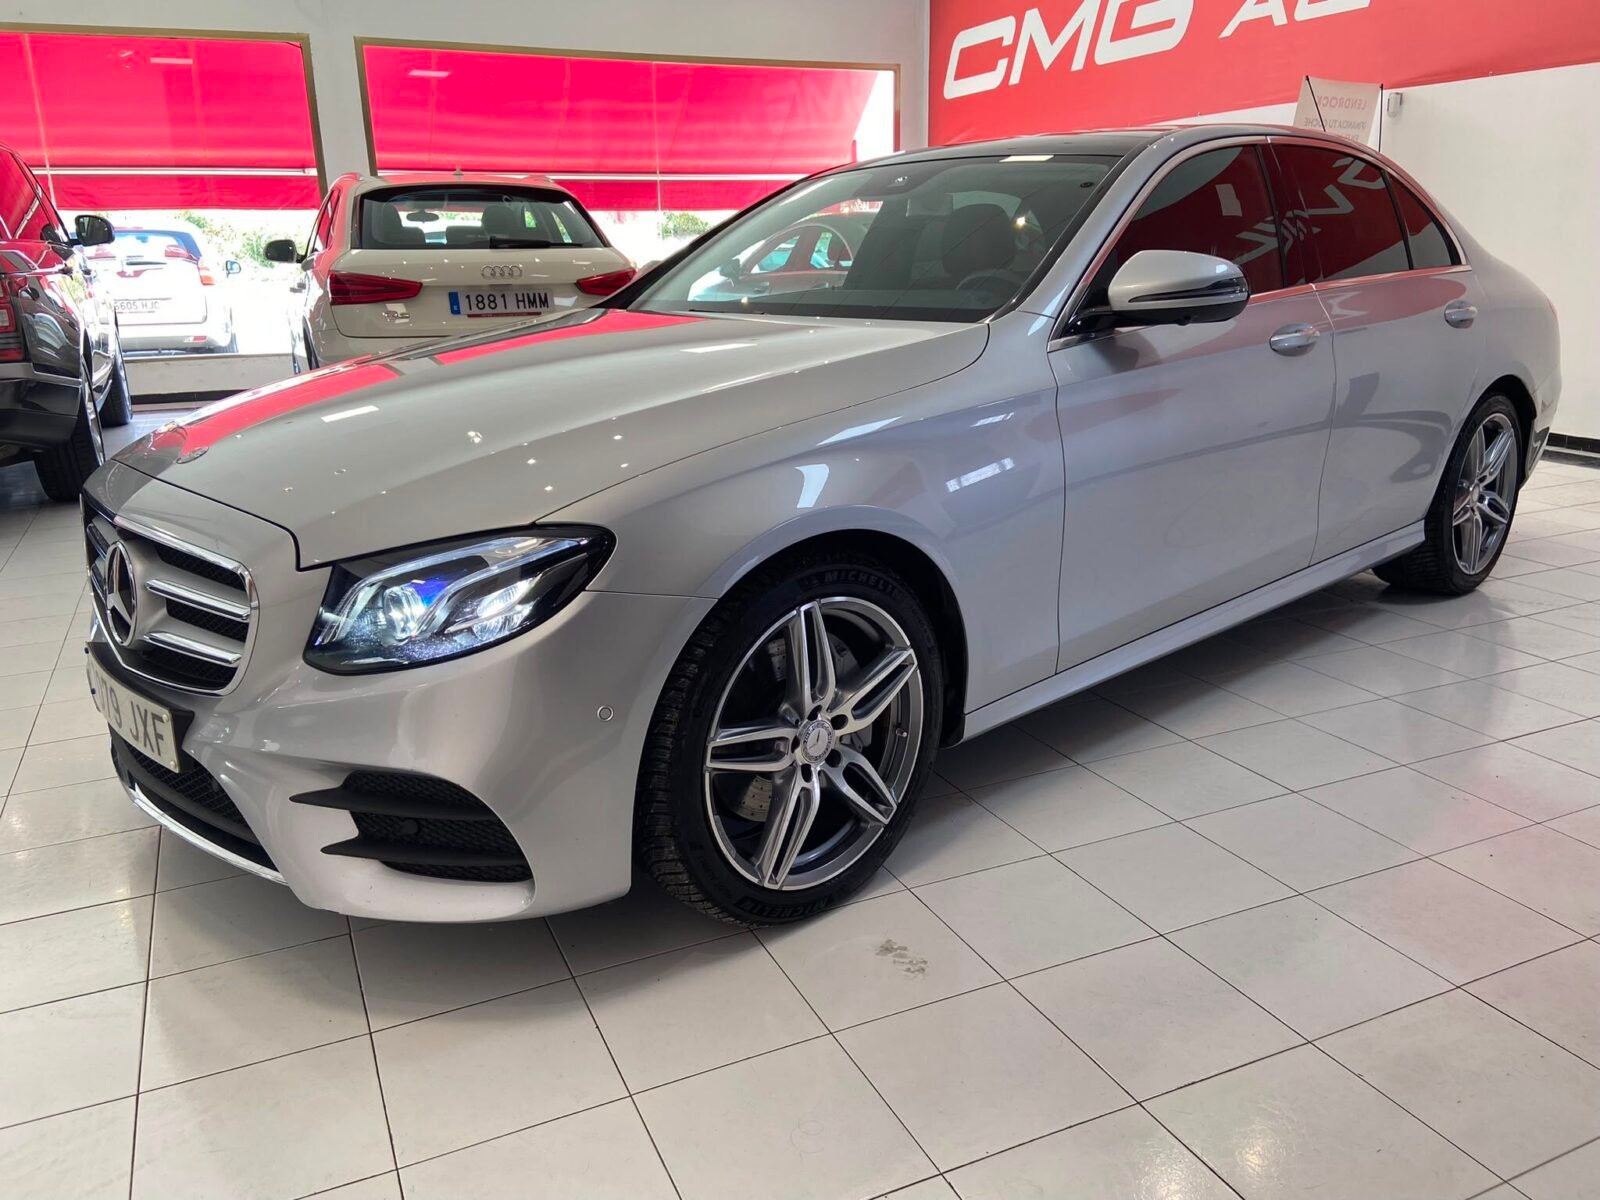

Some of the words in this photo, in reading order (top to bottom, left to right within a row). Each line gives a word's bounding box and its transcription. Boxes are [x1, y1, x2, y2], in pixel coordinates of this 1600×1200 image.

[943, 0, 1194, 100] CMG
[465, 293, 508, 311] 1881
[515, 292, 549, 309] HMM
[130, 700, 167, 757] JXF
